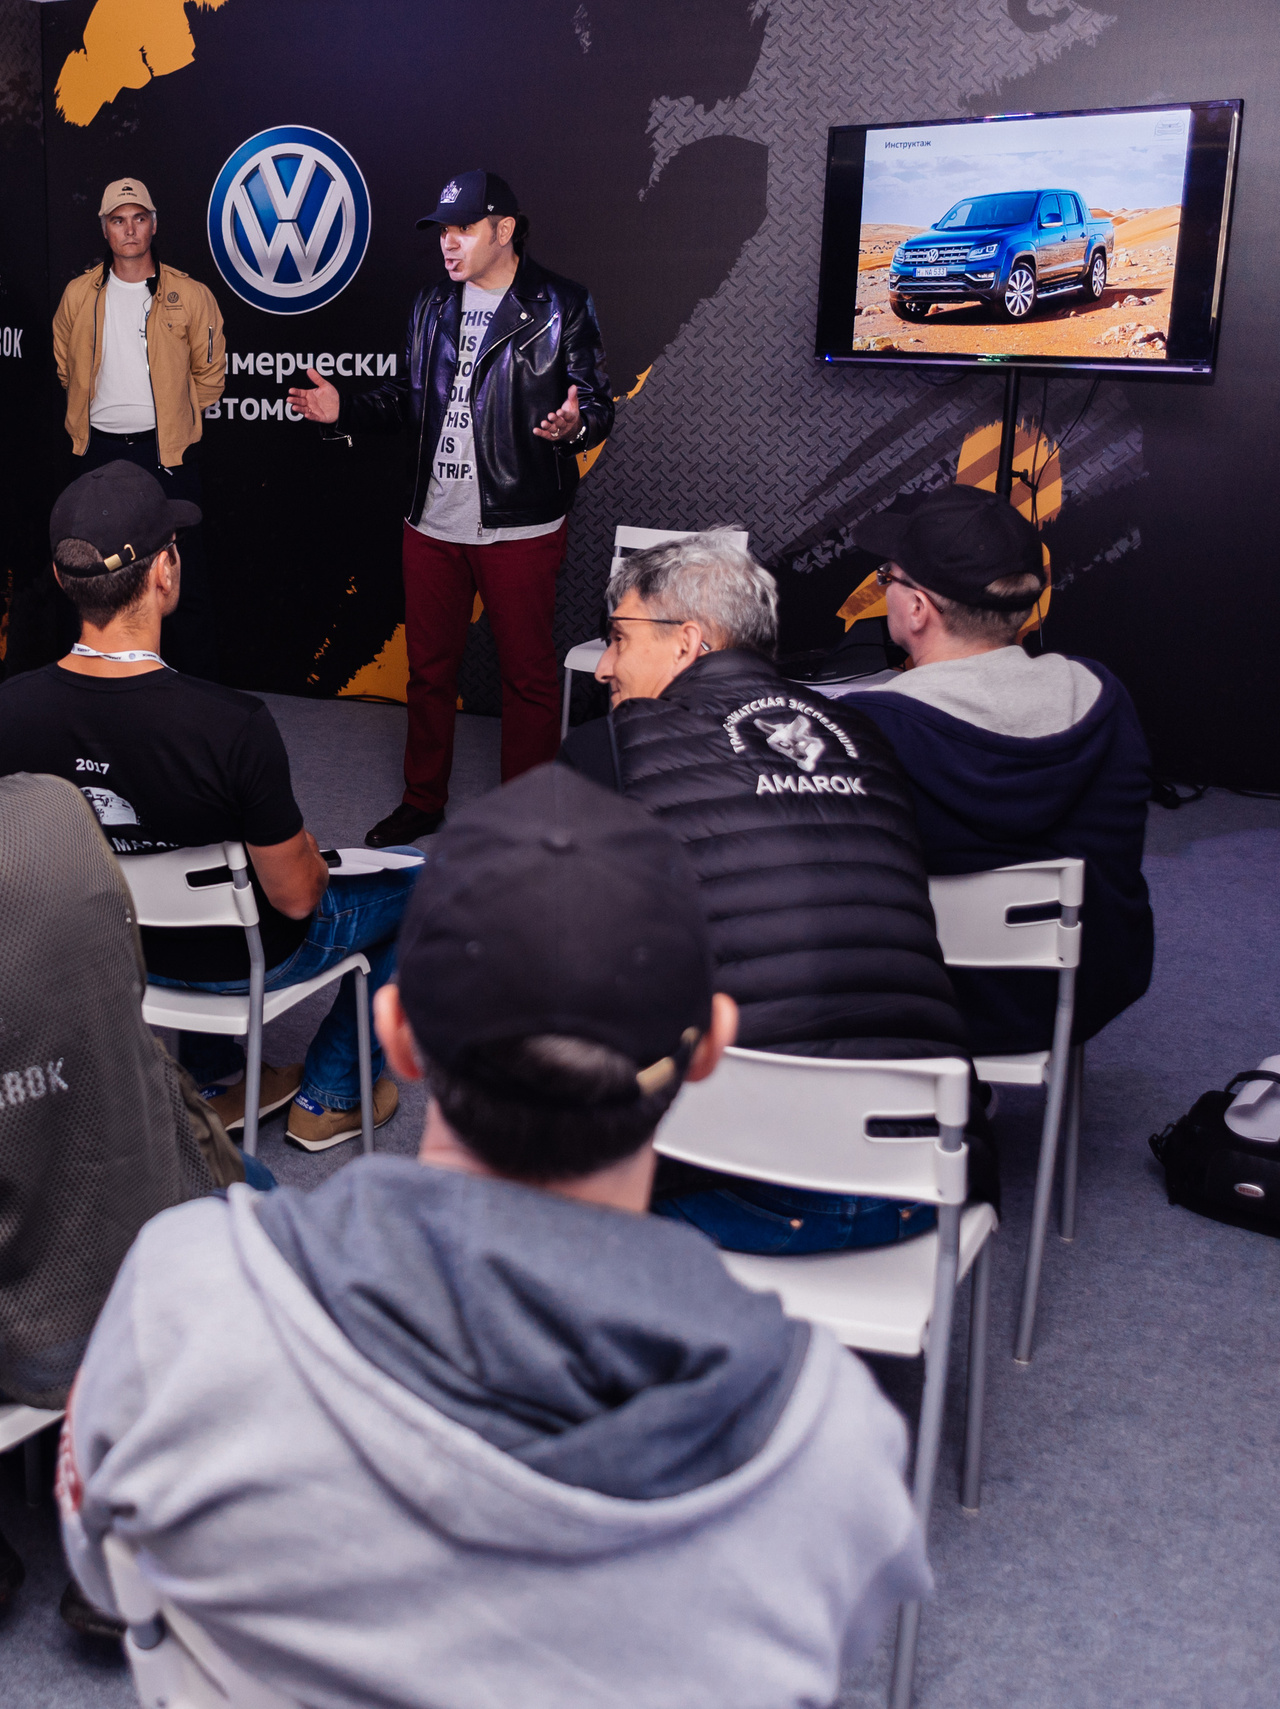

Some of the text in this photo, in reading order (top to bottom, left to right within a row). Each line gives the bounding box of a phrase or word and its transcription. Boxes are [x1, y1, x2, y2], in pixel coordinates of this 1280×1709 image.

[884, 141, 932, 149] Инструктаж
[460, 335, 477, 352] IS
[445, 411, 470, 429] HIS
[440, 436, 455, 454] IS
[437, 461, 473, 480] TRIP.
[75, 758, 110, 775] 2017
[755, 773, 868, 796] AMAROK
